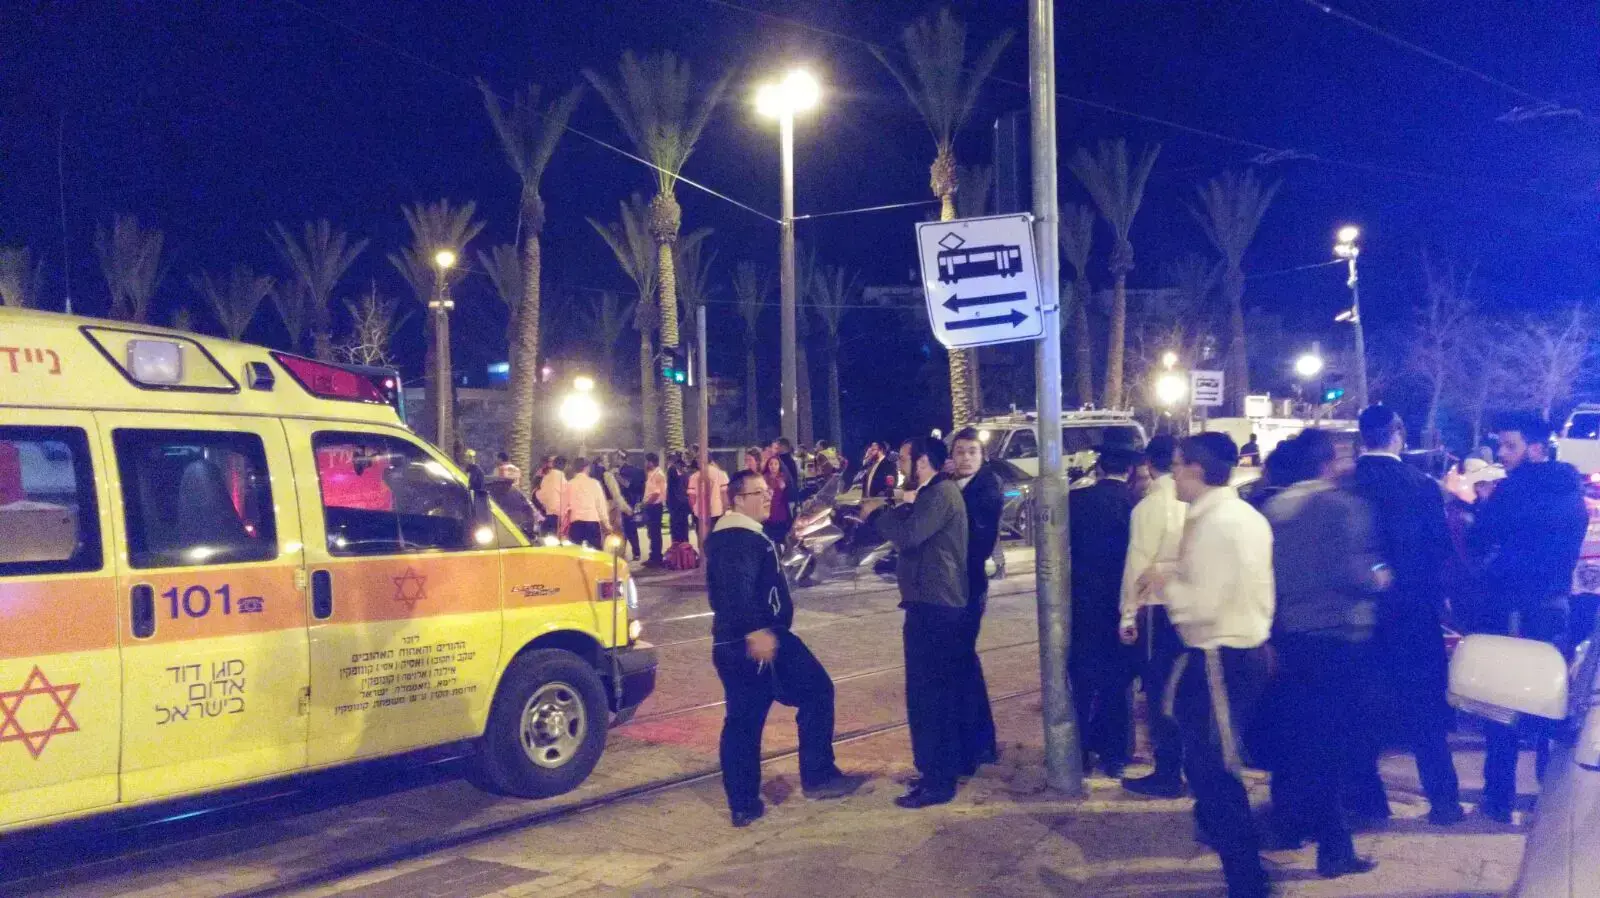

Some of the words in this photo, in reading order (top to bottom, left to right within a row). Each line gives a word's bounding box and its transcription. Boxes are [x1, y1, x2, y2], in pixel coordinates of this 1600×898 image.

[0, 347, 61, 375] נייד
[161, 584, 231, 619] 101
[351, 649, 394, 663] האהובים
[399, 645, 432, 657] והאחות
[437, 641, 466, 652] ההורים
[457, 652, 476, 662] יעקב
[166, 664, 202, 683] דוד
[212, 659, 245, 681] מגן
[433, 666, 457, 677] אילנה
[189, 677, 245, 701] אדום
[155, 697, 245, 725] בישראל
